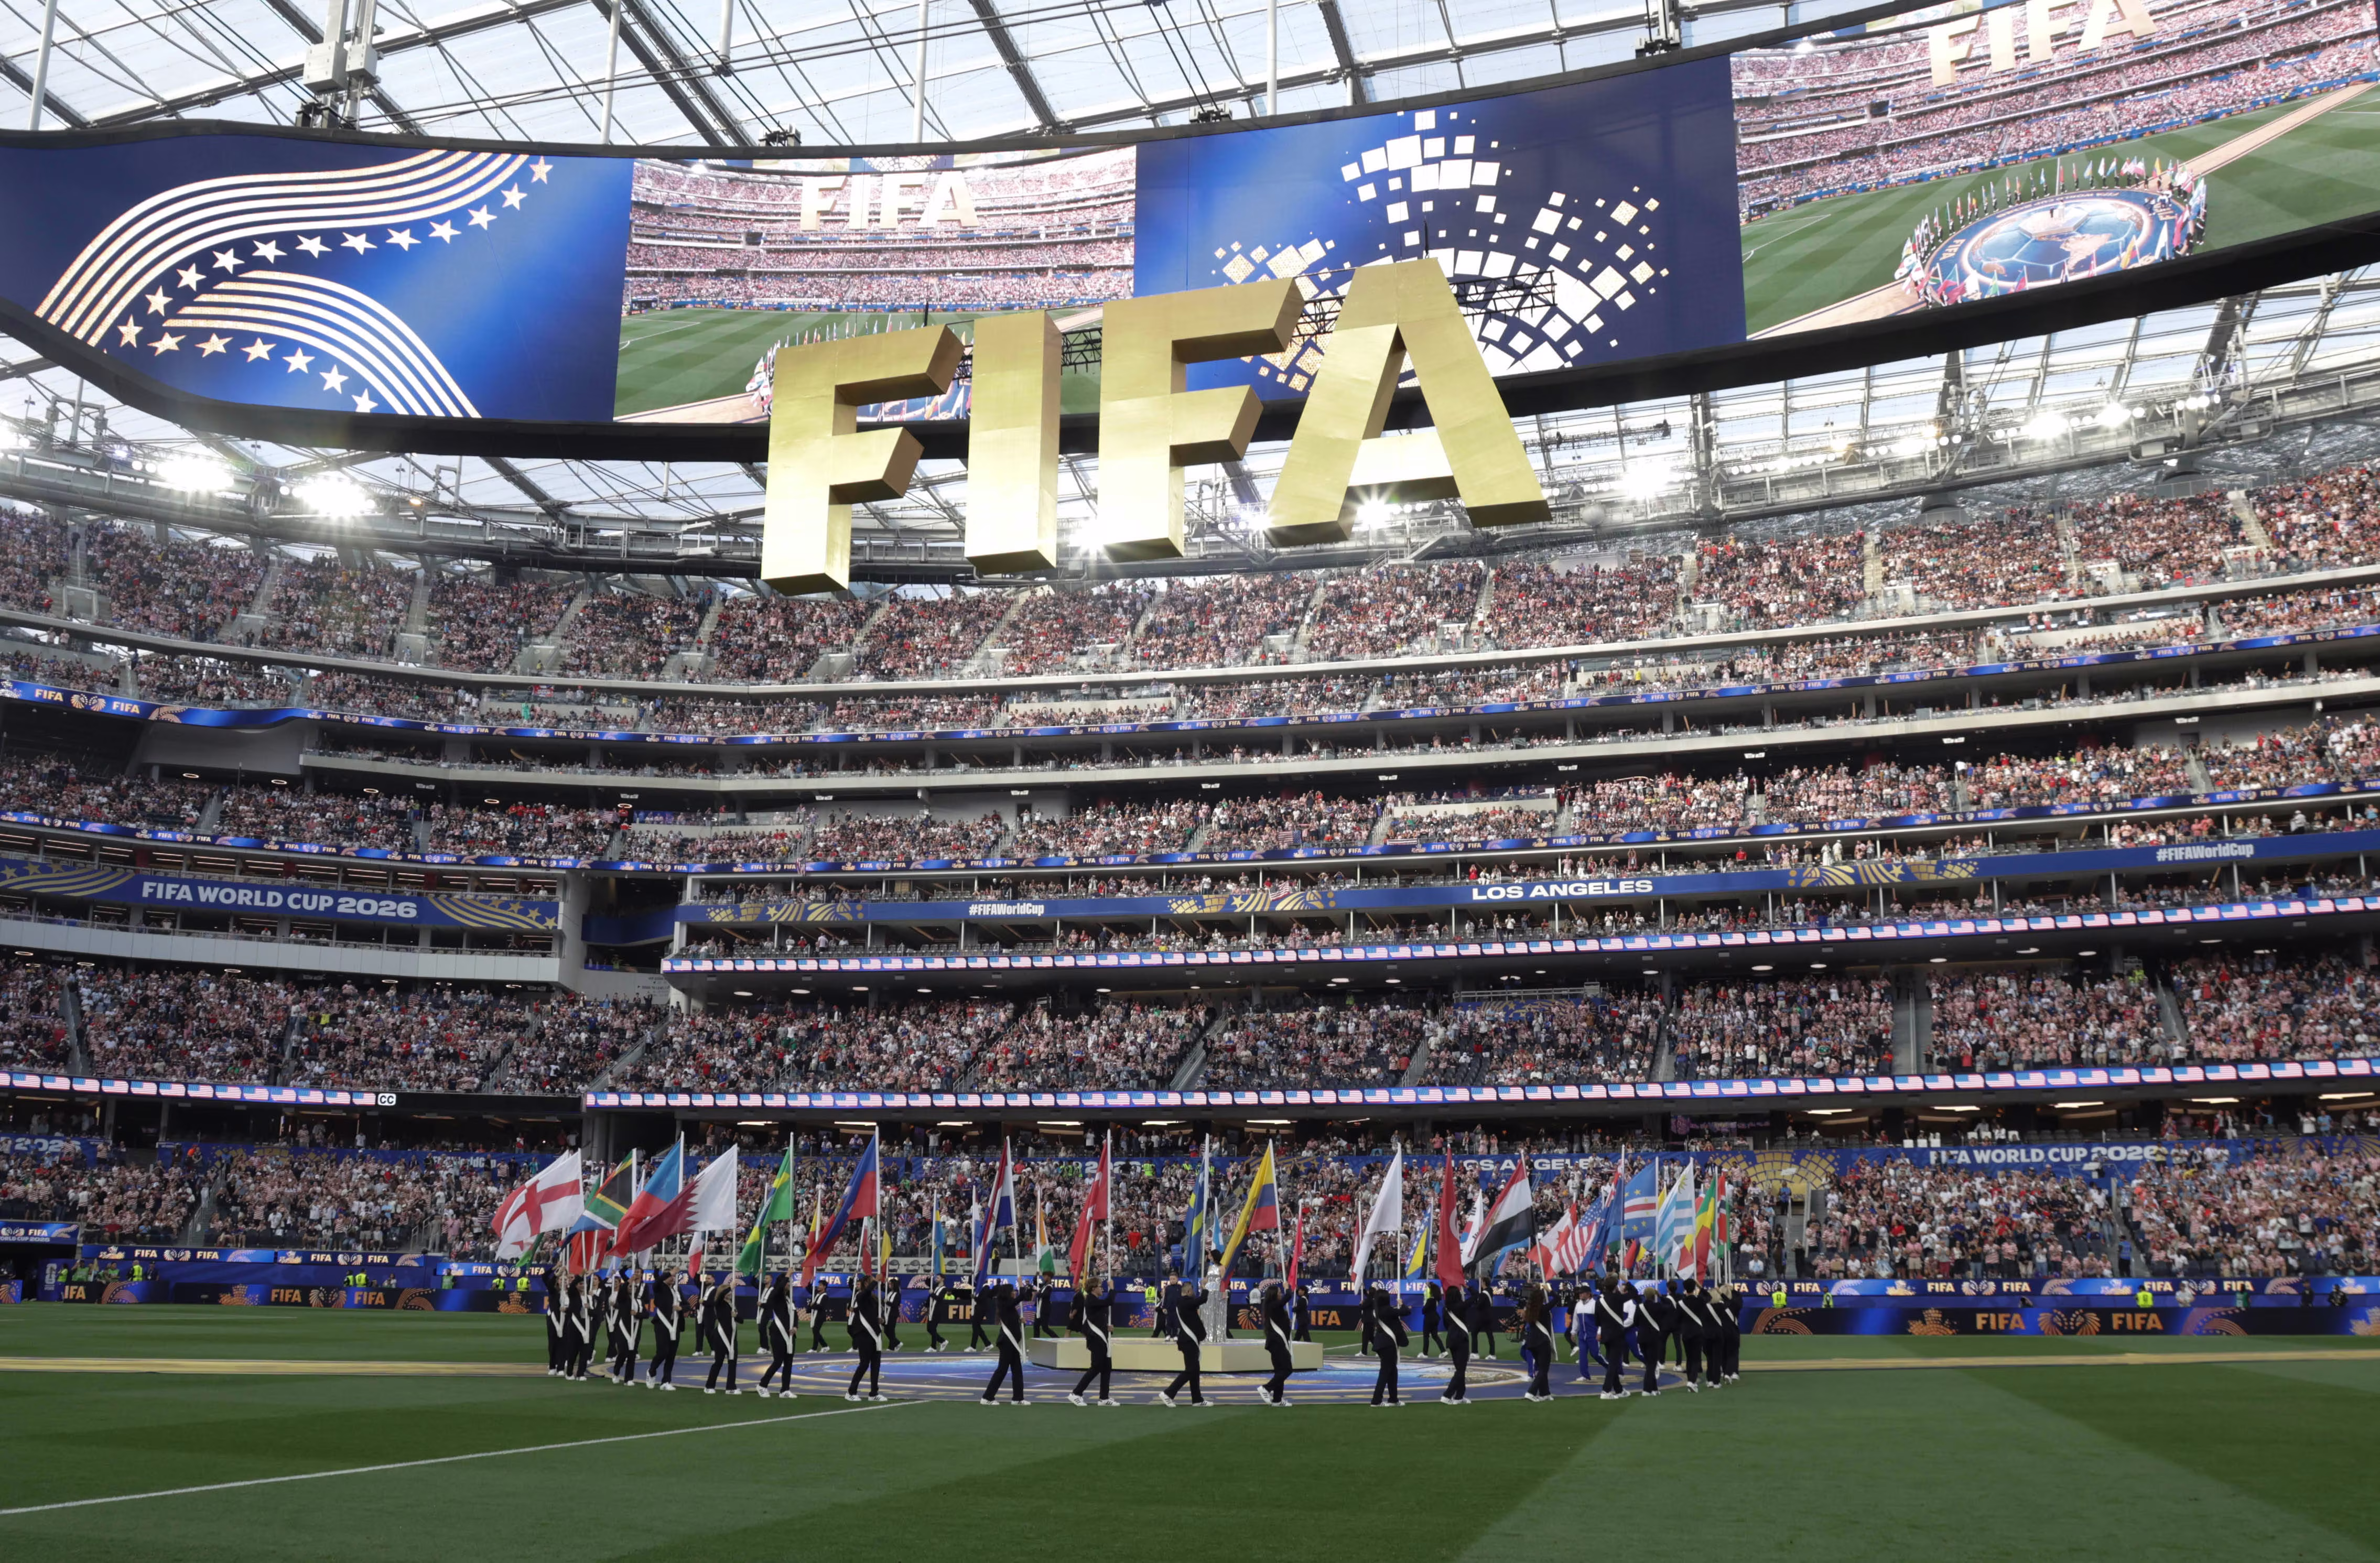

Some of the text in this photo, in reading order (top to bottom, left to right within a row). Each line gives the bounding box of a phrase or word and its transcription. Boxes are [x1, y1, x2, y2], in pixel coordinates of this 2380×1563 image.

[1929, 0, 2158, 87] FIFA
[799, 170, 979, 231] FIFA
[761, 257, 1552, 595] FIFA
[35, 689, 63, 701] FIFA
[112, 701, 140, 713] FIFA
[2156, 843, 2254, 862] #FIFAWorldCup
[1472, 880, 1653, 900] LOS ANGELES
[142, 881, 417, 918] FIFA WORLD CUP 2026
[969, 903, 1044, 916] #FIFAWorldCup
[380, 1095, 394, 1104] CC
[1973, 1148, 2045, 1163] WORLD
[2048, 1147, 2088, 1162] CUP
[134, 1249, 157, 1257] FIFA
[197, 1251, 219, 1259] FIFA
[310, 1253, 332, 1262] FIFA
[367, 1255, 389, 1263] FIFA
[472, 1266, 492, 1274] FIFA
[64, 1285, 86, 1299] IFA
[1794, 1283, 1820, 1293] FIFA
[1927, 1282, 1955, 1292] FIFA
[2002, 1282, 2031, 1291] FIFA
[2144, 1281, 2174, 1291] FIFA
[271, 1289, 302, 1303] FIFA
[354, 1291, 385, 1305] FIFA
[1311, 1310, 1341, 1326] IFA
[1976, 1313, 2026, 1330] FIFA
[2112, 1313, 2164, 1330] FIFA
